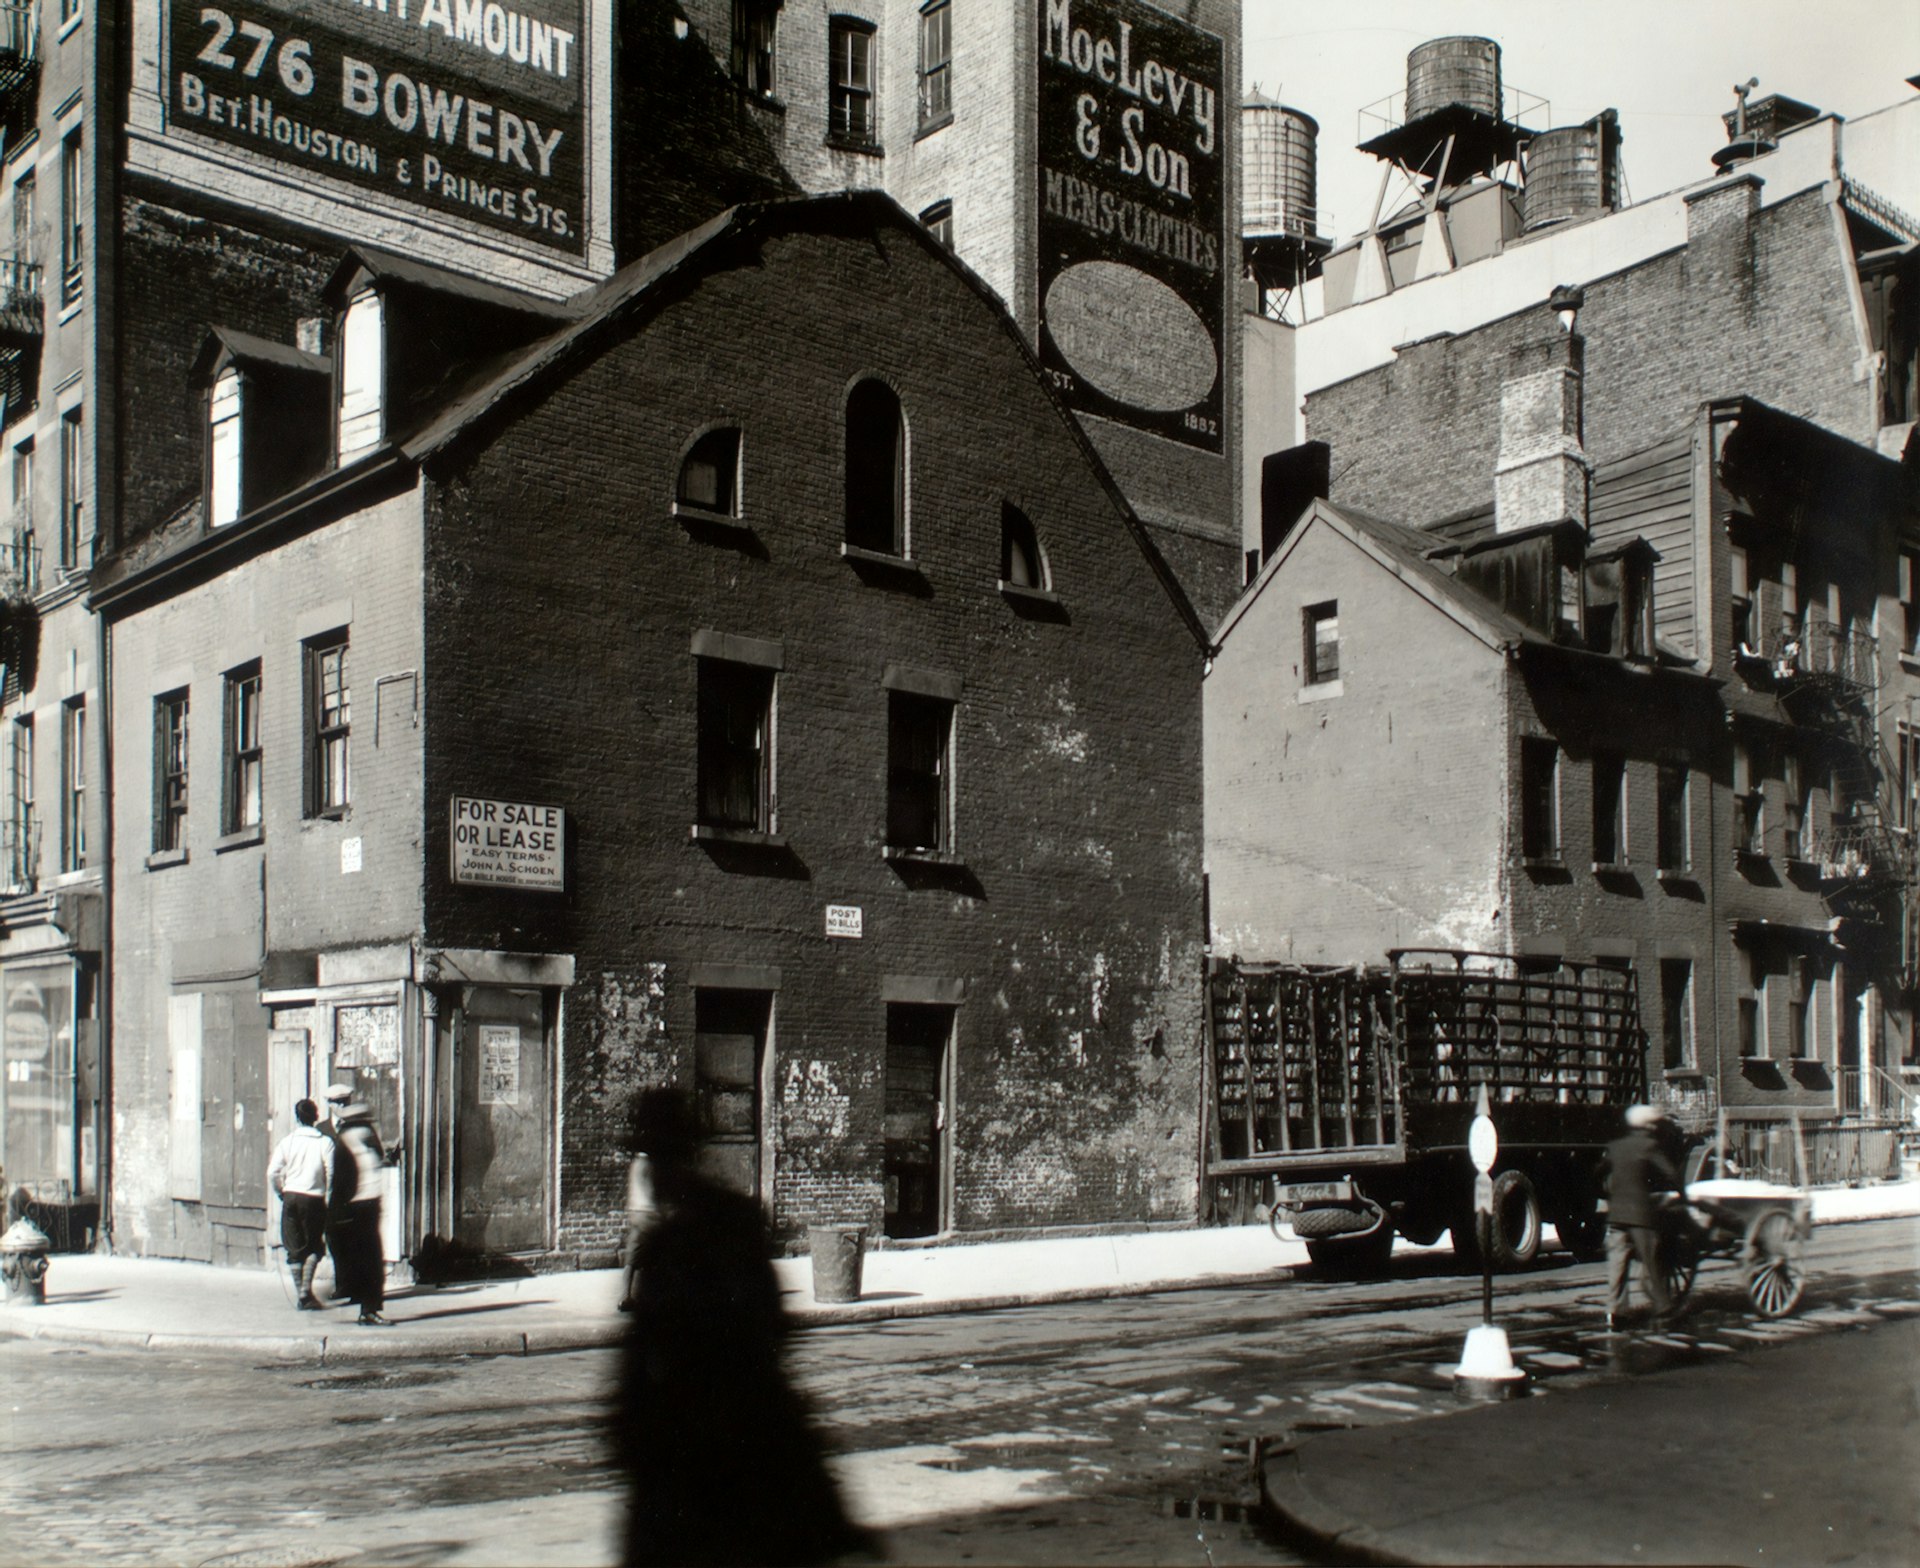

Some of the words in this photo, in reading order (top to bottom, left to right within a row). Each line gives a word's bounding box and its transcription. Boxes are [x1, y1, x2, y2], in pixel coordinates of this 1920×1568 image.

[419, 0, 574, 77] AMOUNT
[197, 7, 315, 96] 276
[342, 56, 563, 177] BOWERY
[1076, 93, 1101, 160] &
[1120, 107, 1192, 200] Son
[251, 94, 377, 173] HOUSTON
[397, 158, 412, 185] &
[423, 153, 517, 219] PRINCE
[521, 188, 575, 238] STS.
[1184, 412, 1218, 436] 1882
[458, 800, 496, 822] FOR
[503, 805, 557, 828] SALE
[457, 825, 479, 845] OR
[486, 826, 556, 851] LEASE
[462, 859, 493, 870] JOHN
[509, 862, 555, 875] SCHOEN
[472, 848, 502, 858] EASY
[506, 851, 545, 862] TERMS
[828, 918, 838, 927] NO
[839, 919, 860, 928] BILLS
[831, 909, 857, 918] POST
